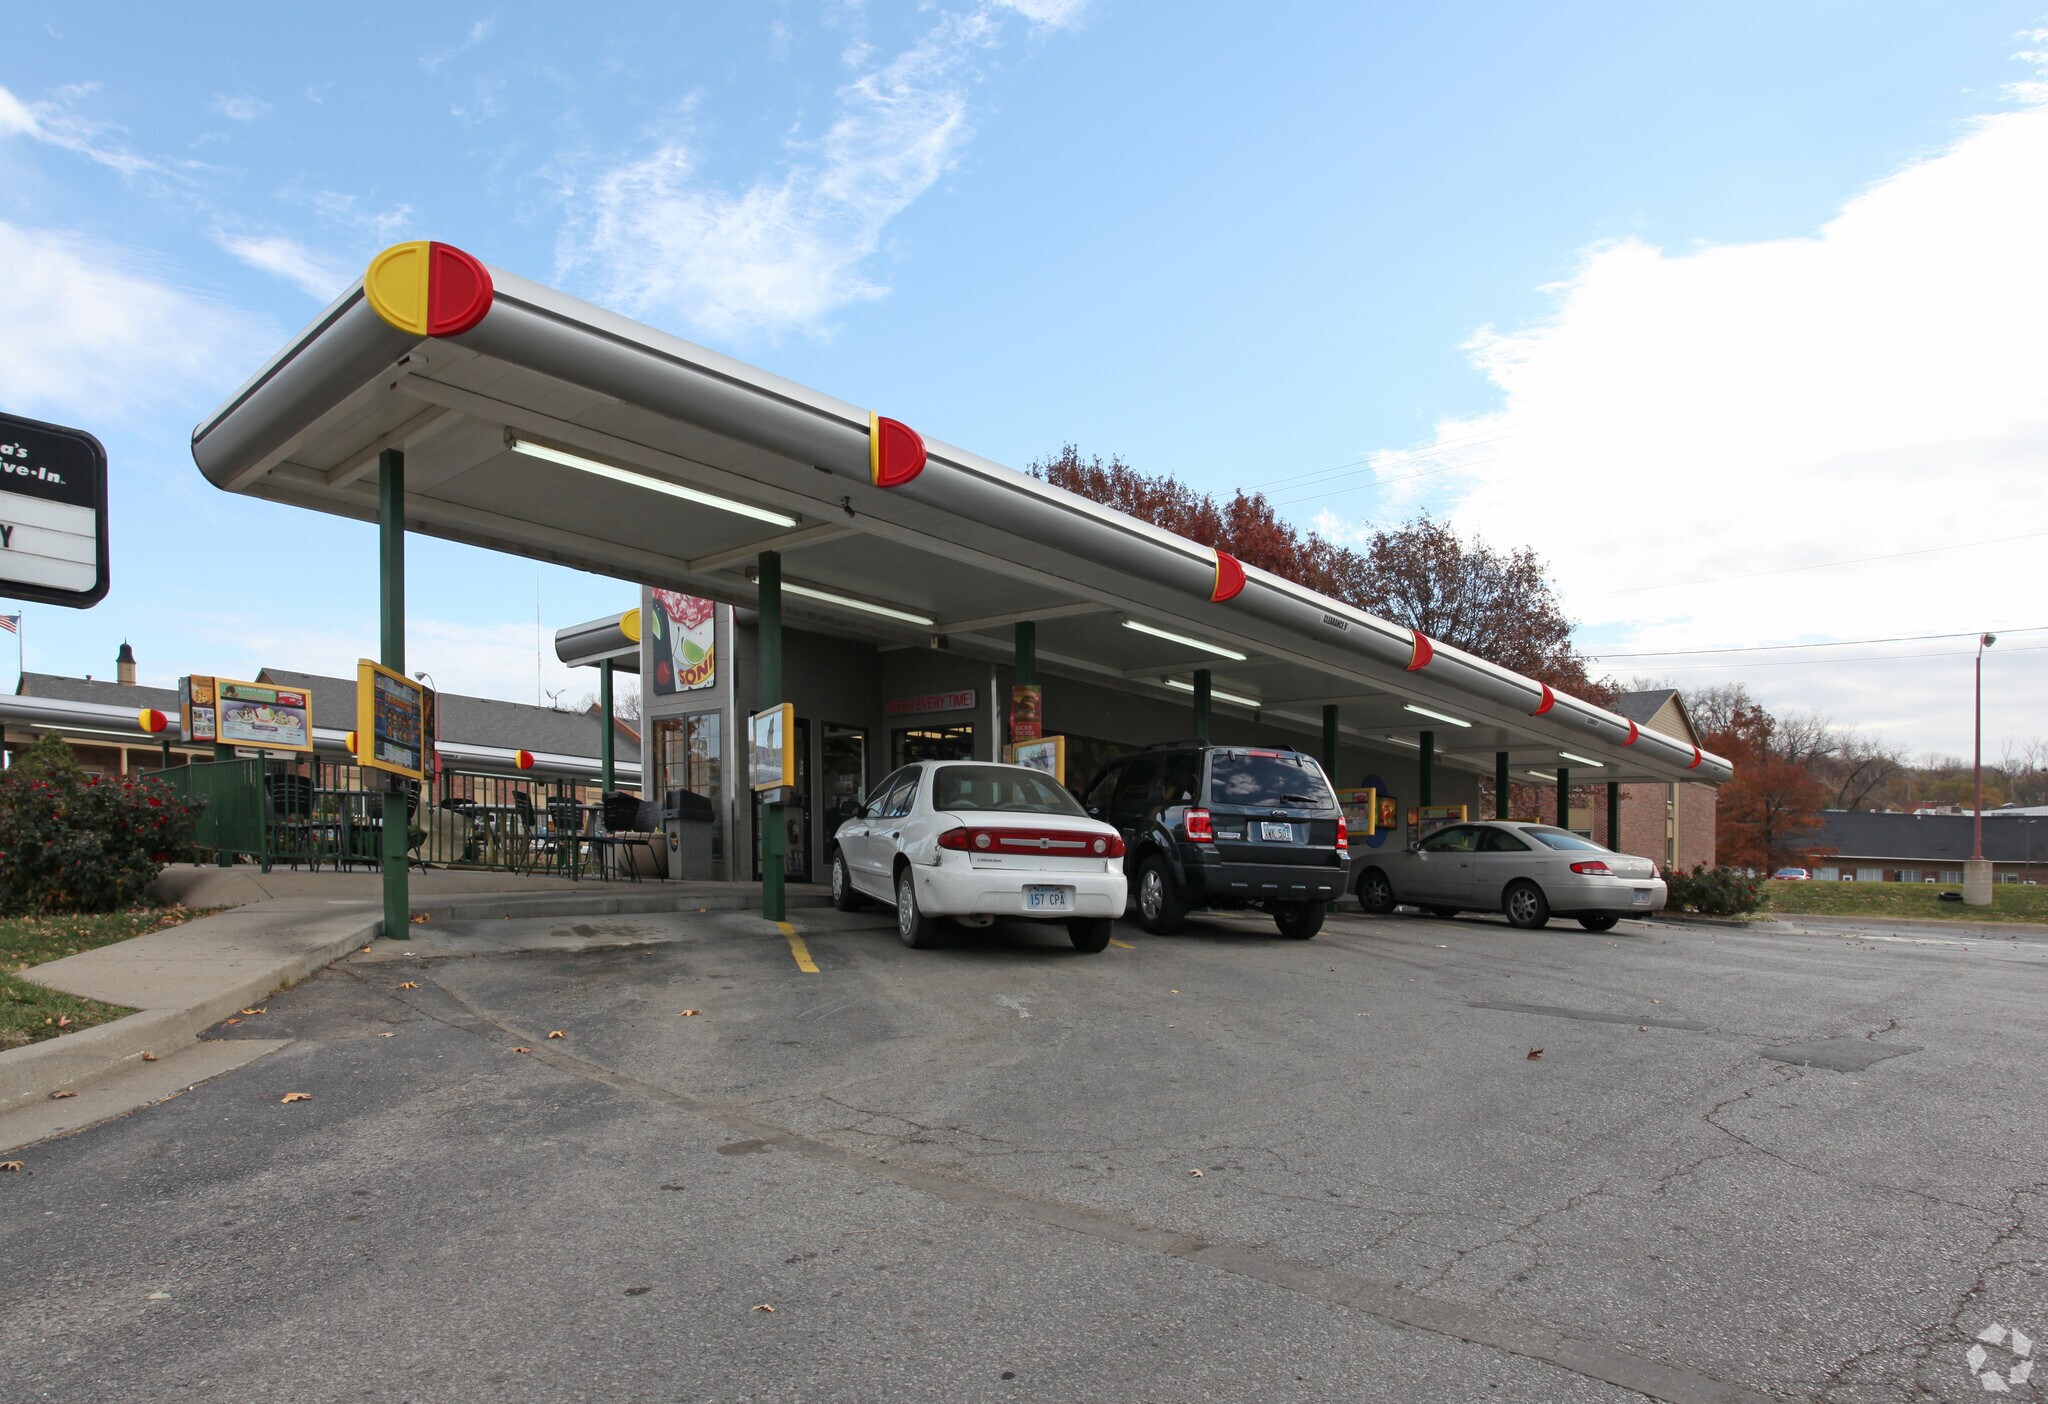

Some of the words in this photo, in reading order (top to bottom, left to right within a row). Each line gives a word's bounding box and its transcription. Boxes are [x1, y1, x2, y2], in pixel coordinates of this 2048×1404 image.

[915, 694, 946, 712] EVERY
[947, 691, 974, 707] TIME!
[1030, 893, 1045, 906] 157
[1049, 893, 1066, 906] CPA
